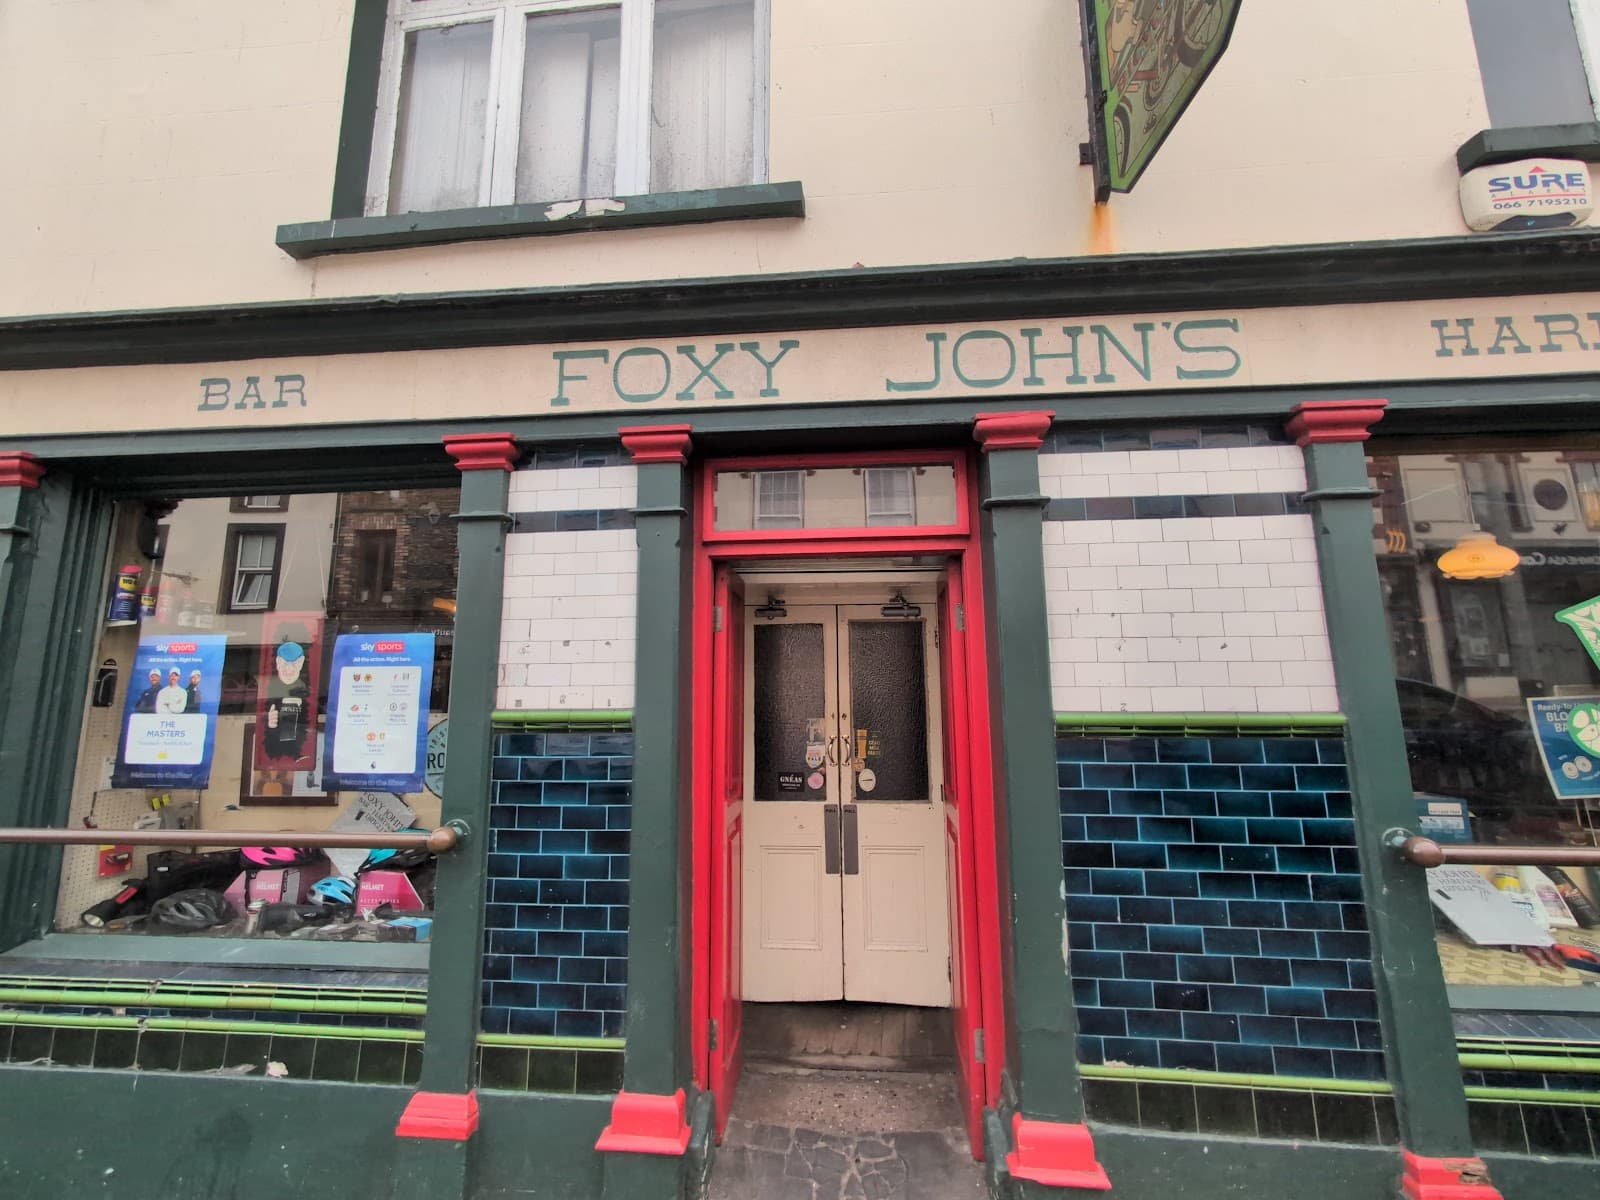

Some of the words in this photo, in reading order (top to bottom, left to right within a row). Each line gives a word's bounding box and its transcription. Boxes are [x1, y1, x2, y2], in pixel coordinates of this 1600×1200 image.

[1488, 173, 1585, 193] SURE
[1493, 201, 1522, 209] 066
[1527, 198, 1587, 207] 7195210
[551, 340, 800, 406] FOXY
[886, 318, 1242, 392] JOHN'S
[197, 374, 307, 412] BAR
[156, 644, 168, 653] sky
[170, 644, 196, 653] sports
[360, 642, 374, 652] sky
[377, 643, 403, 652] sports
[160, 720, 176, 728] THE
[146, 730, 186, 738] MASTERS
[361, 881, 384, 891] HELMET
